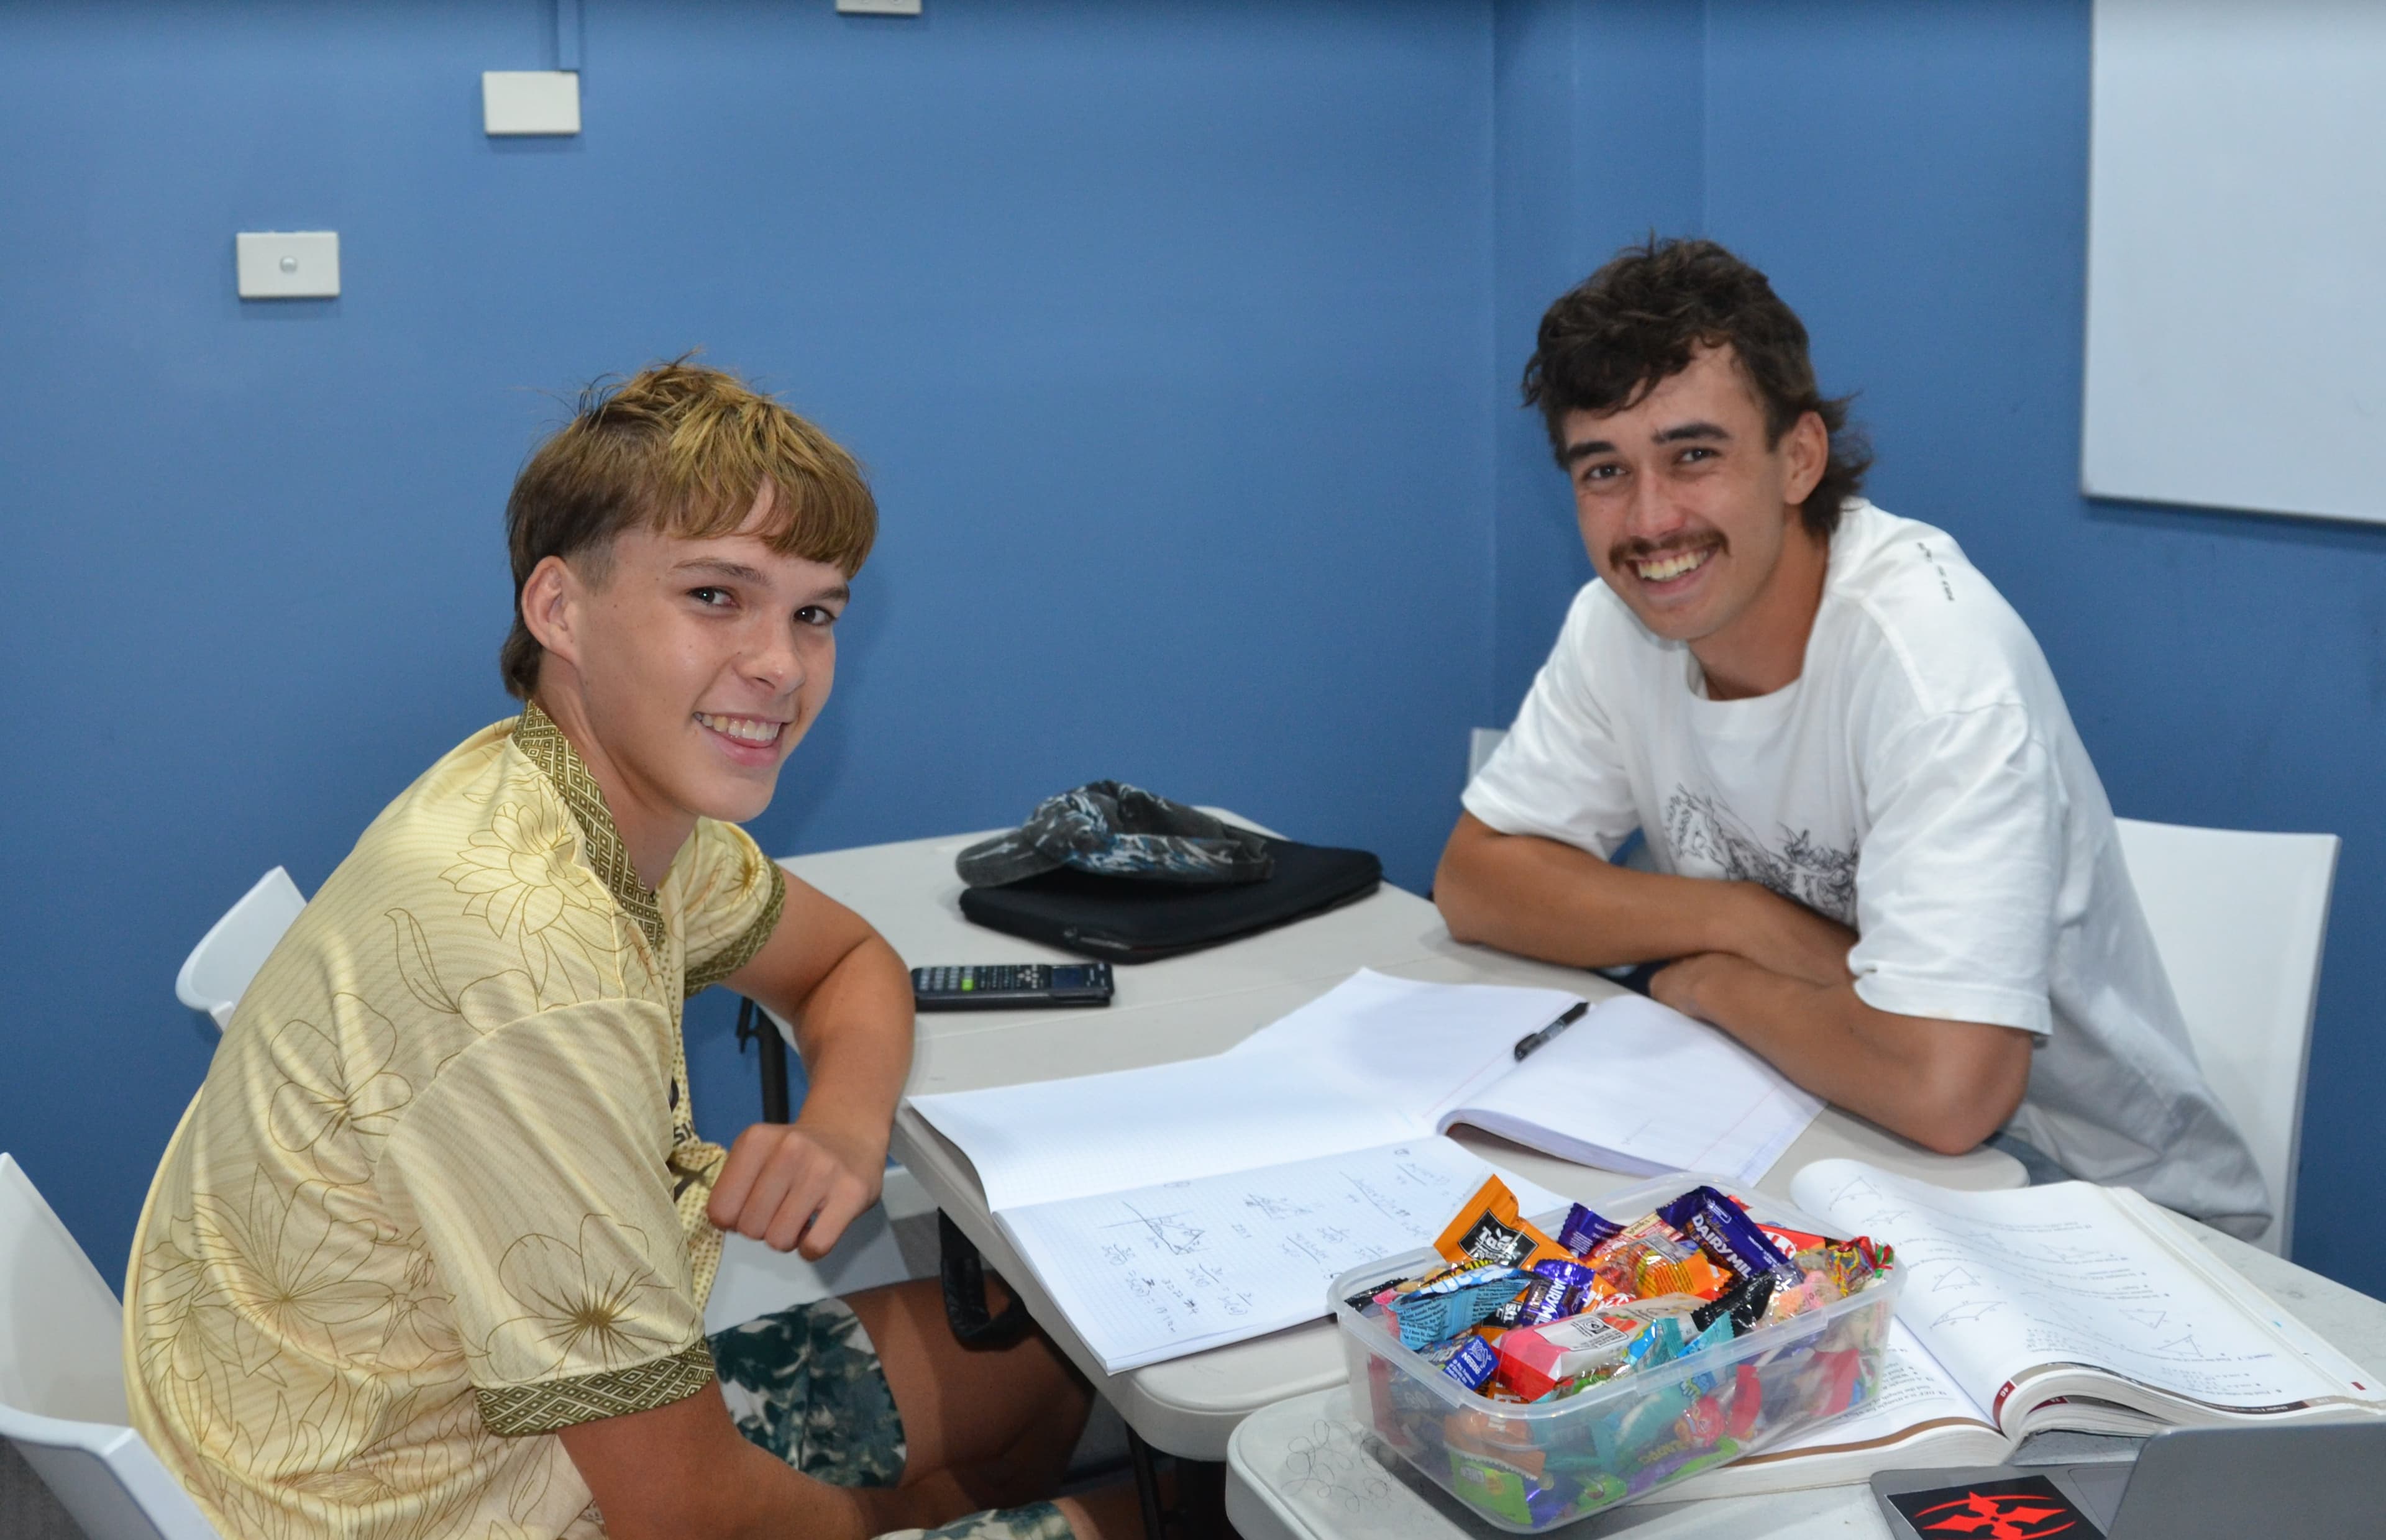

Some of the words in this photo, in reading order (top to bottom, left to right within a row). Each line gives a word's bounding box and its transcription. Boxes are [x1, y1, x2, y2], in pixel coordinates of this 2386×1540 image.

[1691, 1213, 1734, 1254] DAIRY
[1726, 1252, 1752, 1280] MIL
[1532, 1303, 1555, 1326] MIL
